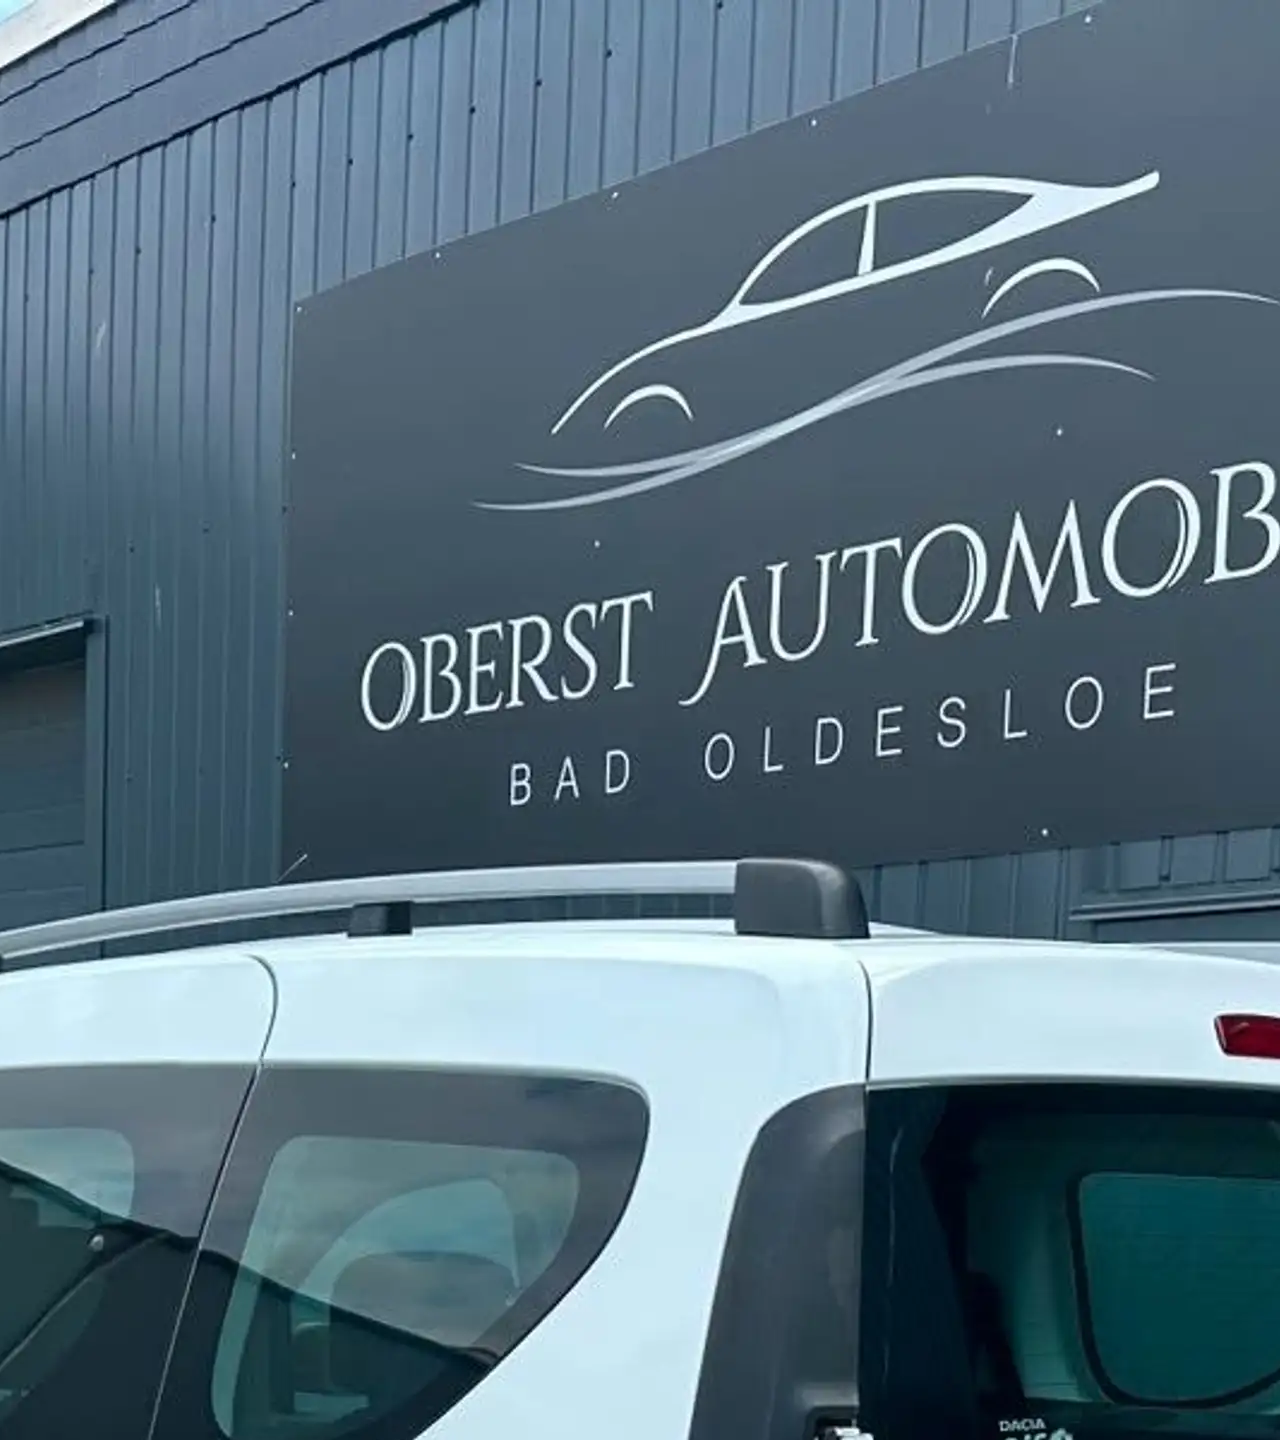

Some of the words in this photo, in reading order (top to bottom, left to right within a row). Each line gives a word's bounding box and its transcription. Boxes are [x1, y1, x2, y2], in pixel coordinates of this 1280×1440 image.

[361, 590, 654, 731] OBERST
[510, 749, 630, 806] BAD
[705, 663, 1177, 781] OLDESLOE
[998, 1417, 1047, 1432] DACIA
